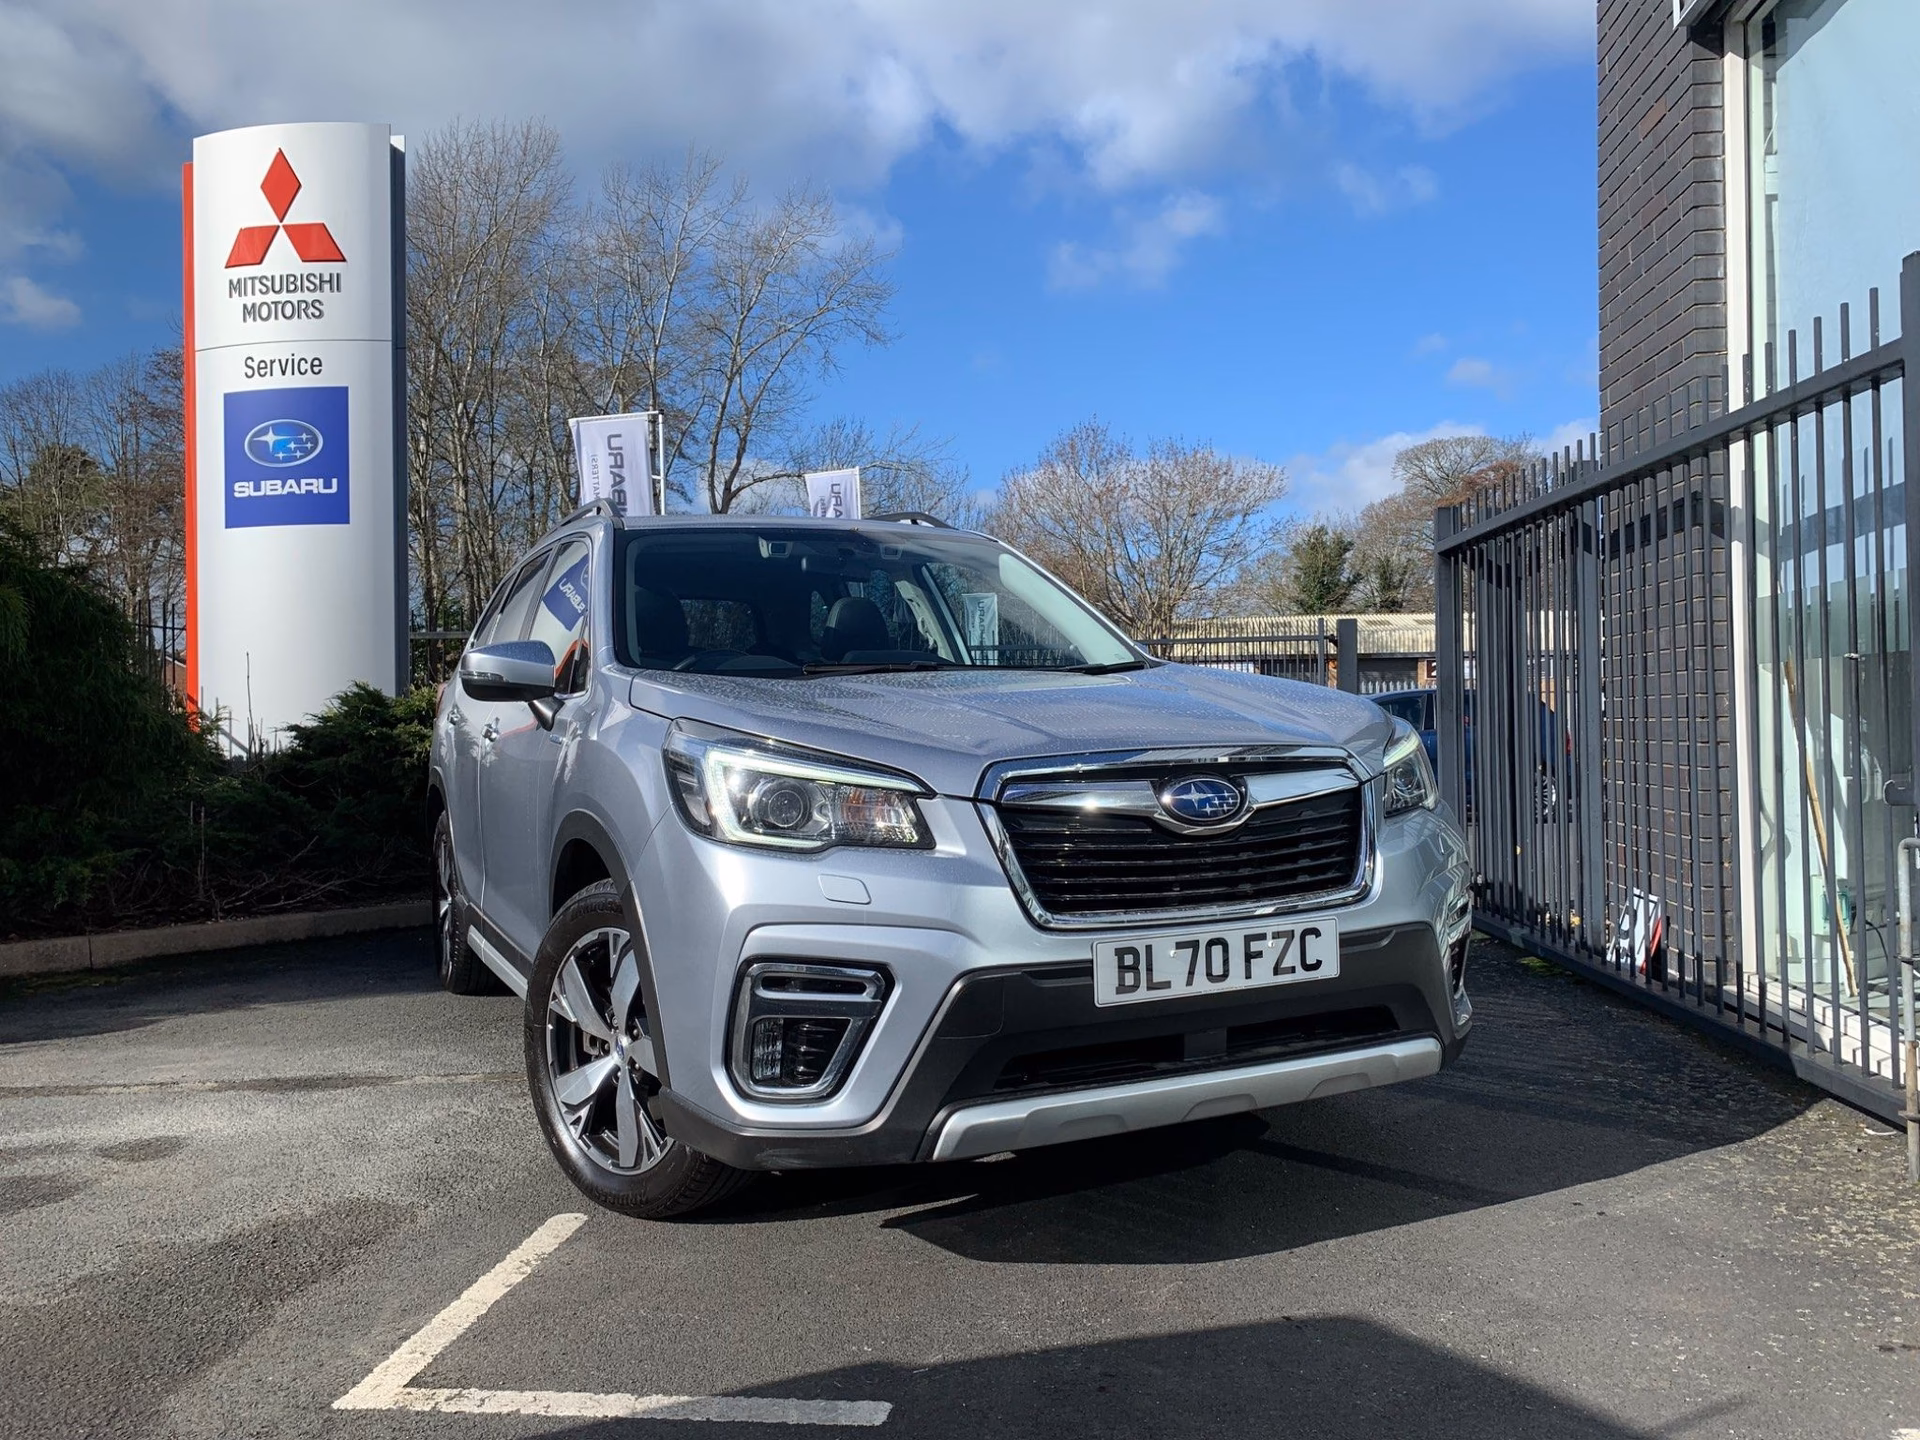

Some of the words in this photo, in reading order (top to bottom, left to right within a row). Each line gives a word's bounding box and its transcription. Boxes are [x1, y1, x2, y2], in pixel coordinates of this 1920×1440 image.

[228, 272, 342, 299] MITSUBISHI
[242, 299, 325, 323] MOTORS
[243, 353, 324, 379] Service
[233, 478, 338, 498] SUBARU
[1114, 937, 1229, 996] BL70
[1243, 926, 1323, 980] FZC
